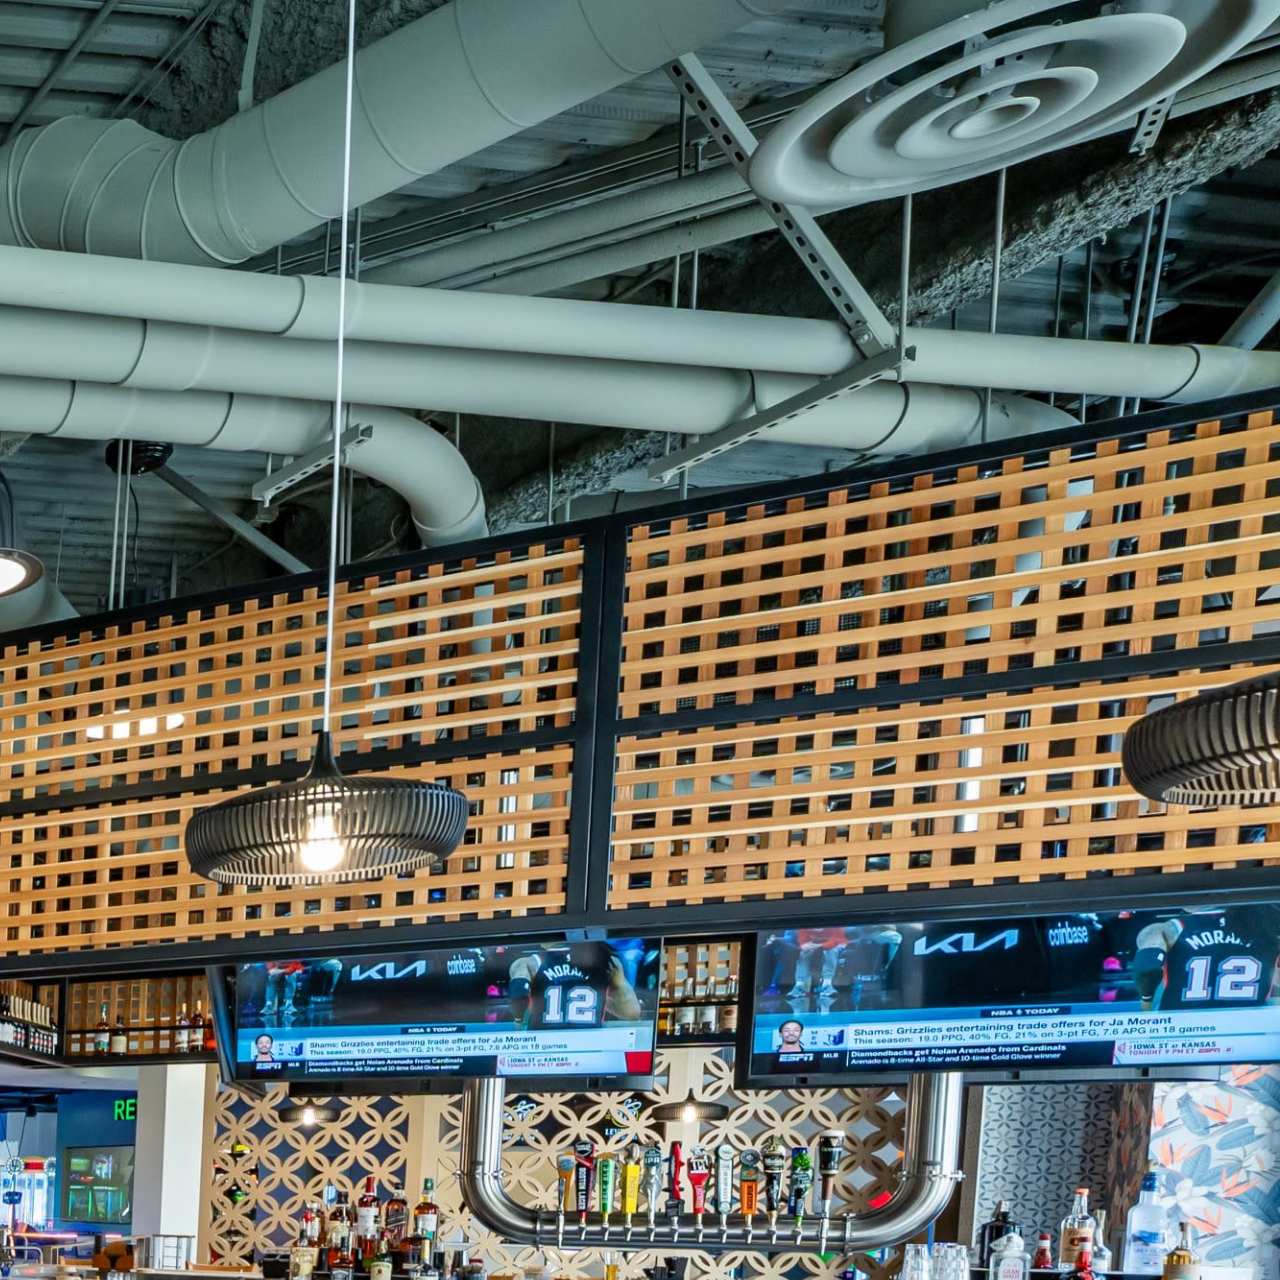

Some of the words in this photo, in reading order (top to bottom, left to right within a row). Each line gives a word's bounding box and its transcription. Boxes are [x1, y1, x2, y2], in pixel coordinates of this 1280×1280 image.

[913, 928, 1019, 956] KIA
[1048, 921, 1089, 946] coinbase
[351, 960, 426, 981] KIA
[447, 955, 476, 975] coinbase
[1181, 955, 1262, 1001] 12
[543, 986, 598, 1024] 12
[991, 1009, 1013, 1017] NBA
[853, 1028, 893, 1037] Shams:
[897, 1026, 940, 1036] Grizzlies
[946, 1022, 1014, 1034] entertaining
[1018, 1021, 1047, 1030] trade
[1051, 1019, 1085, 1029] offers
[1089, 1018, 1106, 1027] for
[1109, 1018, 1124, 1026] Ja
[1128, 1016, 1172, 1026] Morant
[854, 1037, 873, 1045] This
[876, 1036, 913, 1044] season:
[919, 1034, 938, 1042] 19.0
[941, 1033, 966, 1042] PPG,
[969, 1033, 990, 1041] 40%
[995, 1031, 1011, 1040] FG,
[1015, 1031, 1037, 1039] 21%
[1057, 1029, 1080, 1038] 3-pt
[1081, 1028, 1100, 1037] FG,
[1103, 1028, 1119, 1036] 7.6
[1122, 1027, 1146, 1035] APG
[1149, 1026, 1159, 1034] in
[1163, 1025, 1176, 1033] 18
[1178, 1025, 1216, 1035] games
[310, 1041, 337, 1049] Shams:
[340, 1040, 374, 1048] Grizzlies
[376, 1037, 425, 1048] entertaining
[427, 1037, 448, 1045] trade
[452, 1036, 476, 1044] offers
[478, 1036, 491, 1044] for
[505, 1035, 537, 1043] Morant
[328, 1048, 353, 1056] season:
[426, 1045, 443, 1053] 21%
[456, 1045, 472, 1053] 3-pt
[541, 1043, 568, 1051] games
[851, 1050, 913, 1058] Diamondbacks
[914, 1049, 929, 1057] get
[931, 1047, 957, 1055] Nolan
[959, 1046, 996, 1054] Arenado
[998, 1045, 1020, 1053] from
[1022, 1043, 1066, 1052] Cardinals
[367, 1058, 385, 1066] Nolan
[779, 1053, 814, 1062] ESPN
[1010, 1052, 1033, 1060] Glove
[578, 1191, 587, 1210] LAGER
